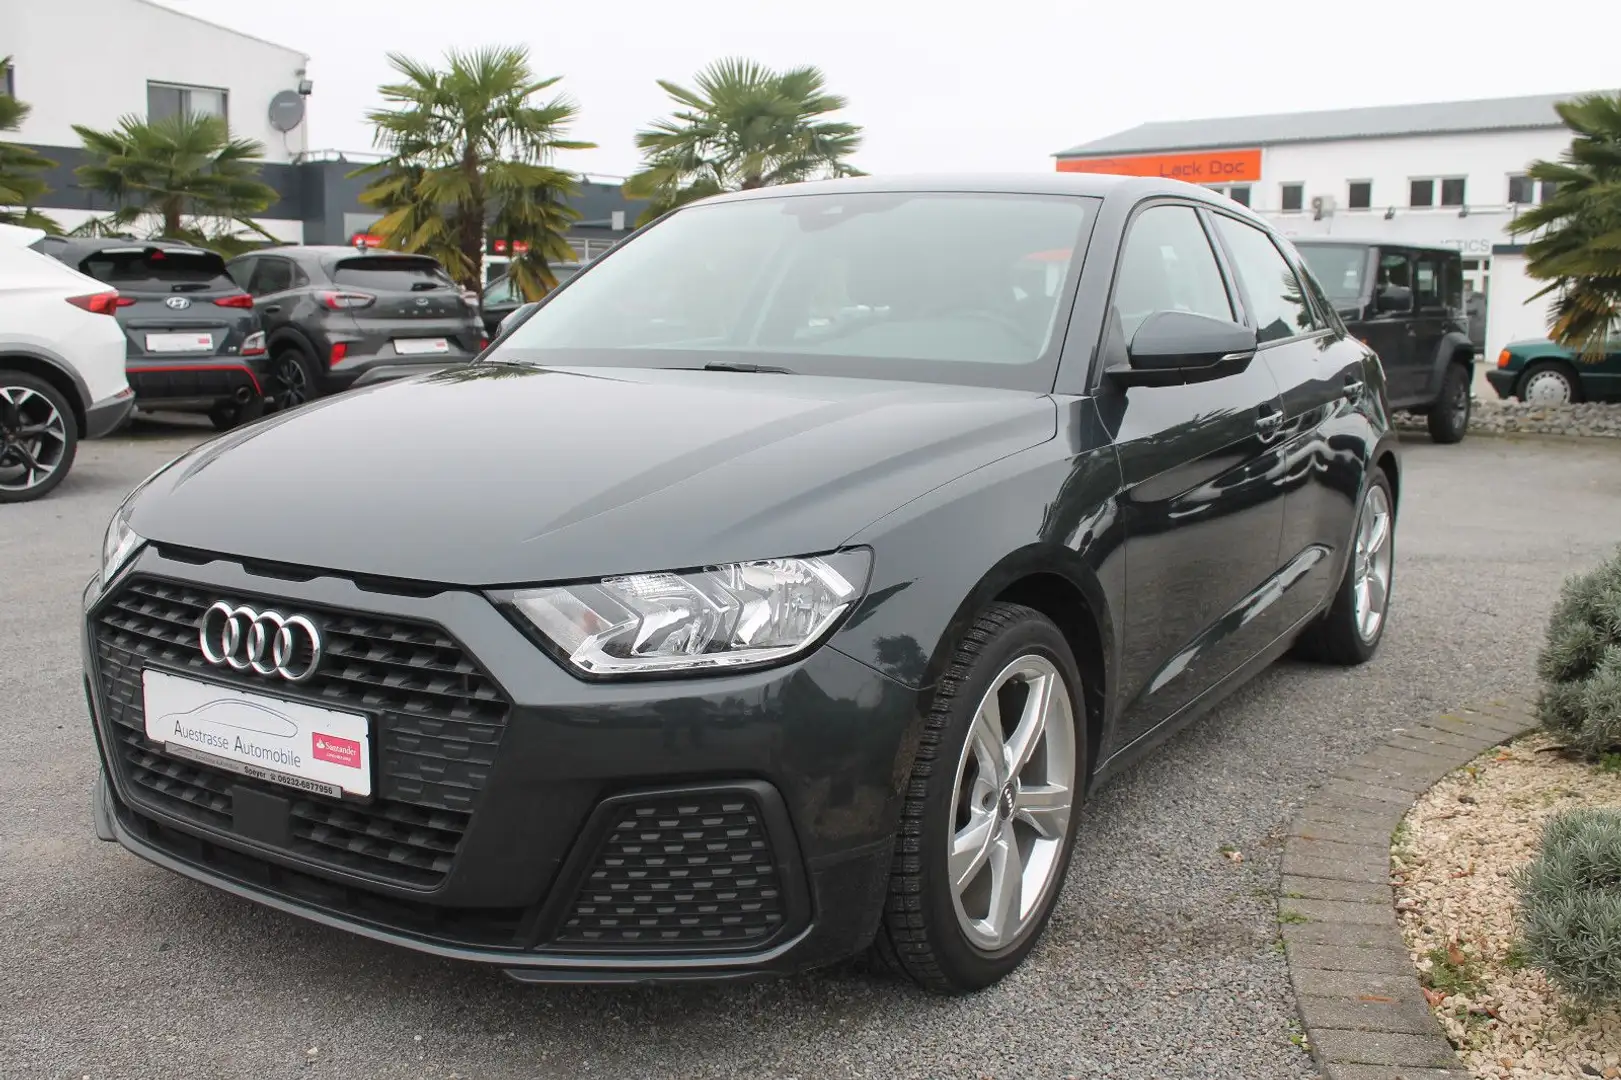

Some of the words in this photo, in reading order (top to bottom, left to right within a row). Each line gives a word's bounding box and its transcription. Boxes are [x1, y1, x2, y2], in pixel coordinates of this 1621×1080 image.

[1160, 161, 1202, 177] Lack
[1209, 160, 1245, 174] Doc
[174, 719, 229, 749] Auestrasse
[234, 735, 301, 768] Automobile
[325, 741, 357, 756] Santander
